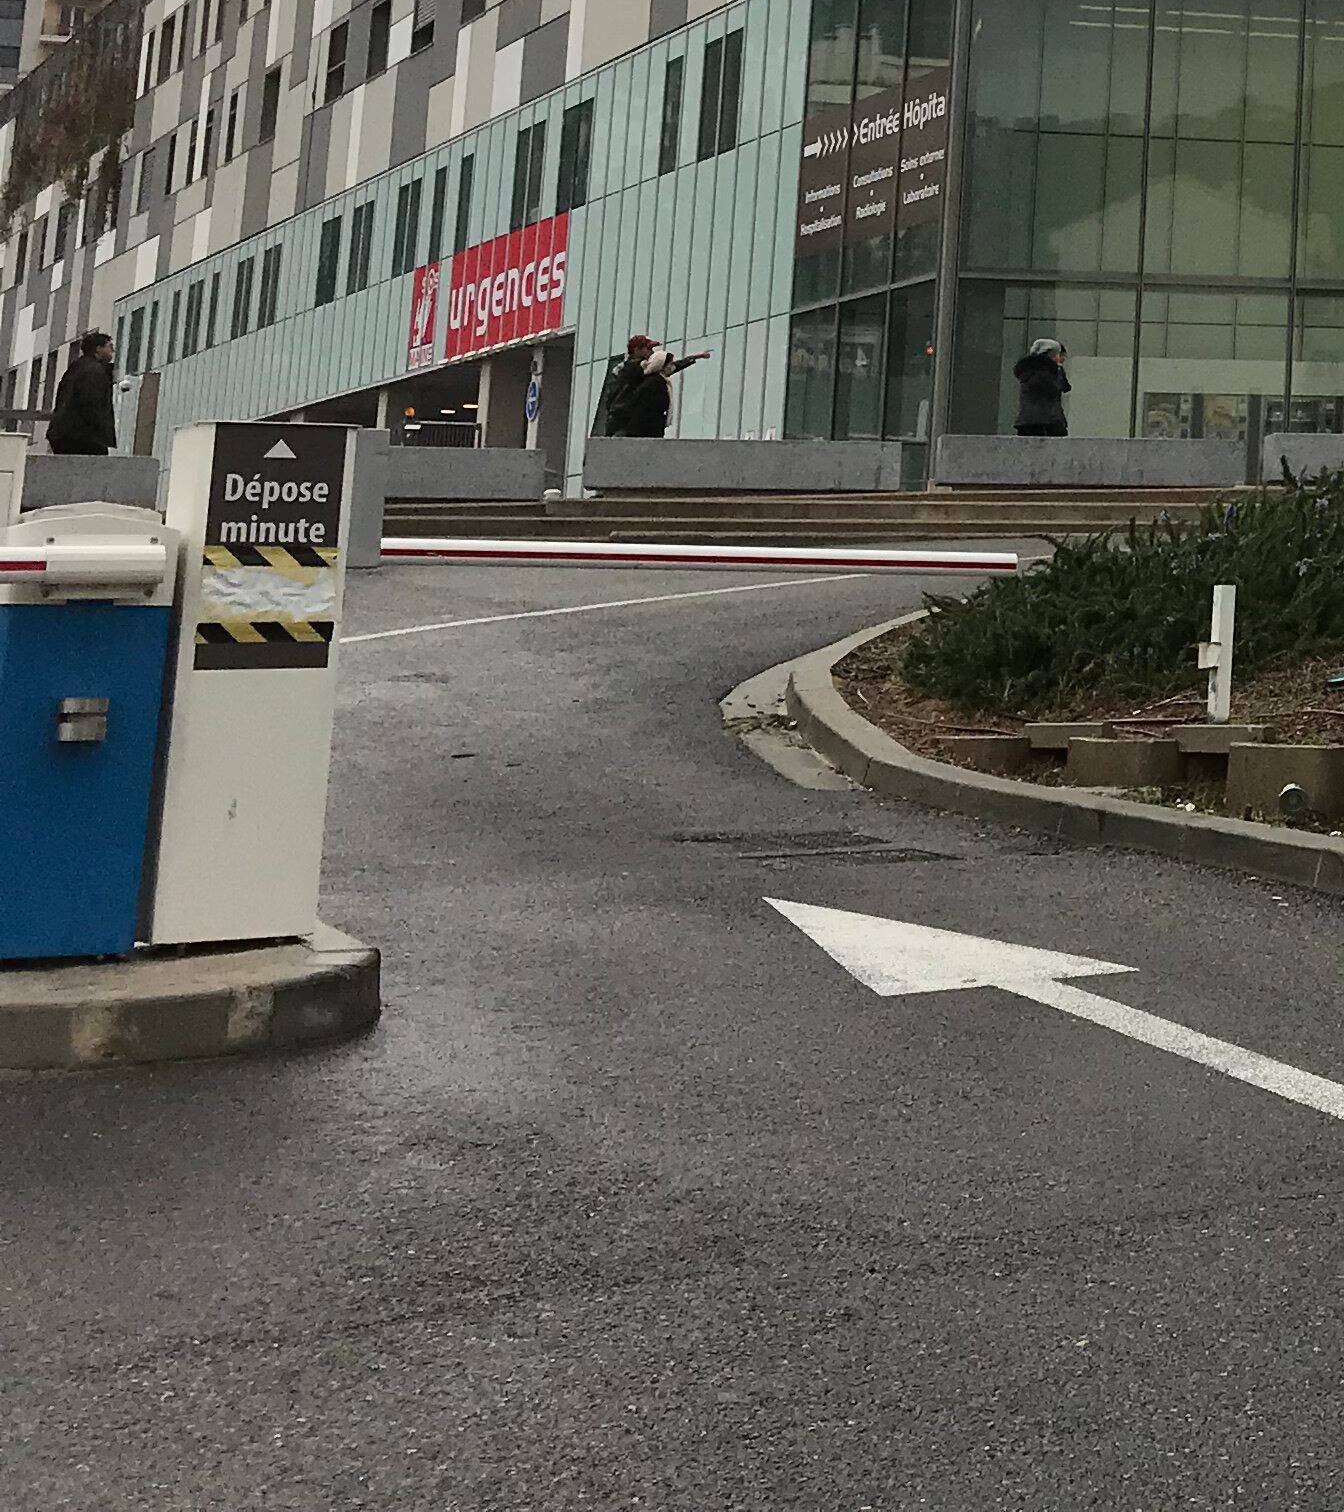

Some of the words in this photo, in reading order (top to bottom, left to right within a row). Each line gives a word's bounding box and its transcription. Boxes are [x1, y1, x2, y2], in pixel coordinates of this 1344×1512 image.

[859, 108, 900, 145] Entrée
[903, 89, 948, 130] Hôpita
[900, 156, 919, 173] Soins
[919, 148, 945, 166] externe
[853, 166, 894, 188] Consultations
[805, 184, 841, 204] Informations
[902, 182, 940, 205] Laboratoire
[855, 200, 887, 220] Radiologie
[800, 214, 842, 237] Hospitalisation
[450, 251, 567, 337] urgences
[224, 473, 330, 509] Dépose
[219, 514, 326, 544] minute
